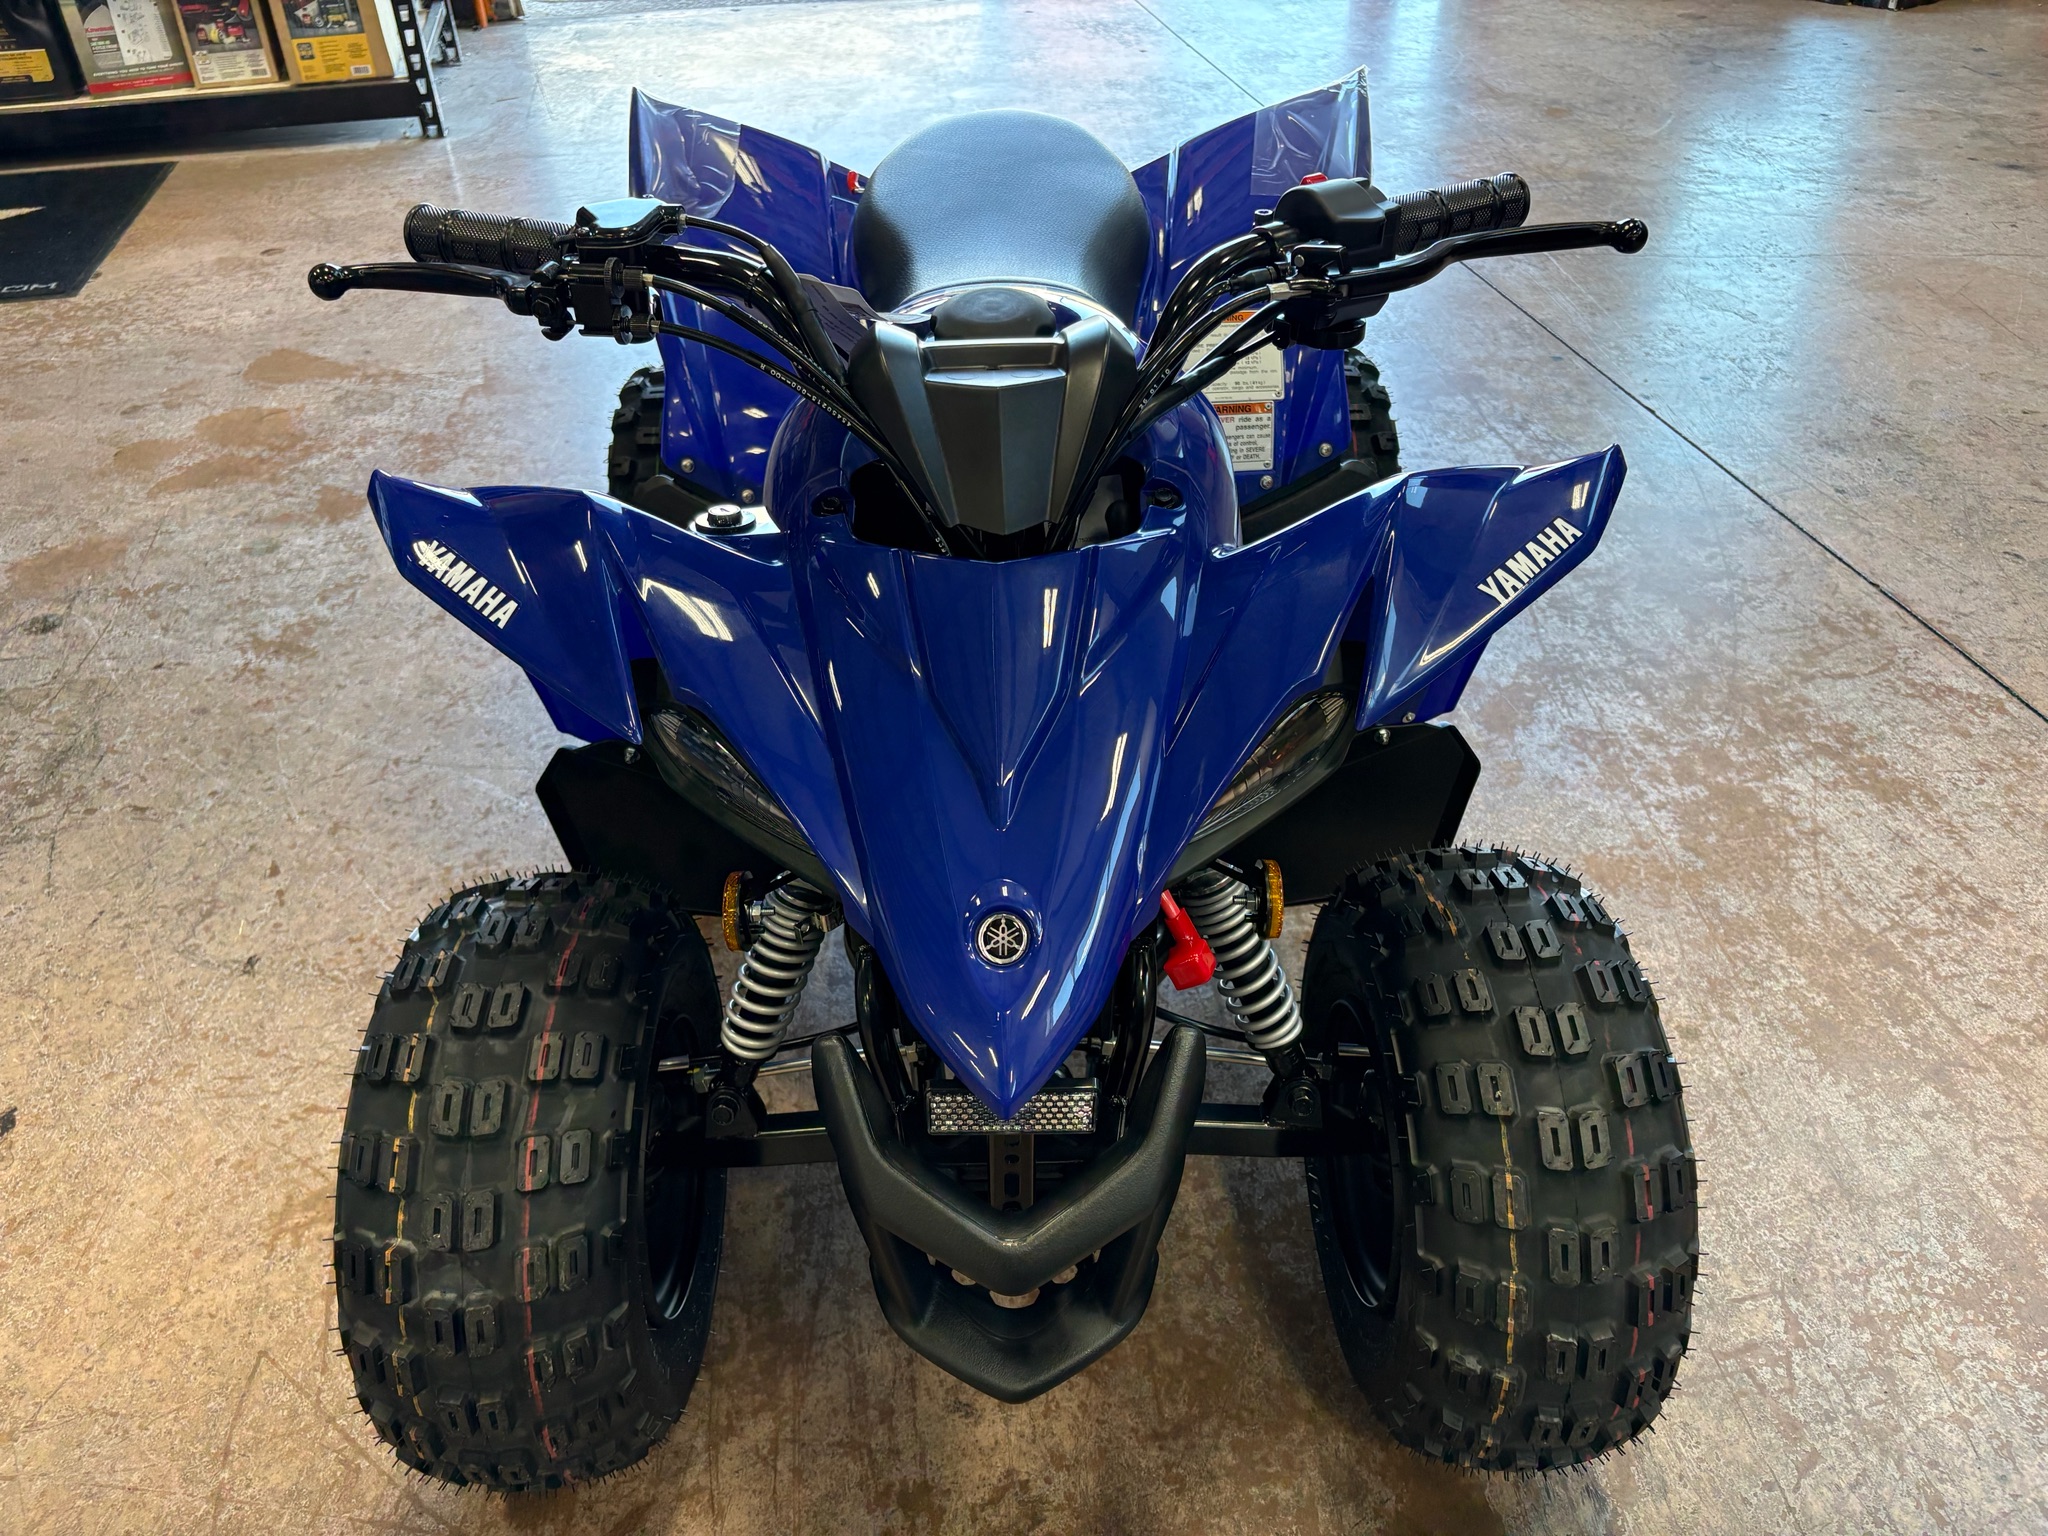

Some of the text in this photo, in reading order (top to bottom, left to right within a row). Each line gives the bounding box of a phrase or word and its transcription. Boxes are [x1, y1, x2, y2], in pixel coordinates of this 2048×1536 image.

[1215, 404, 1252, 415] ARNING
[415, 540, 519, 629] YAMAHA
[1477, 517, 1584, 605] YAMAHA
